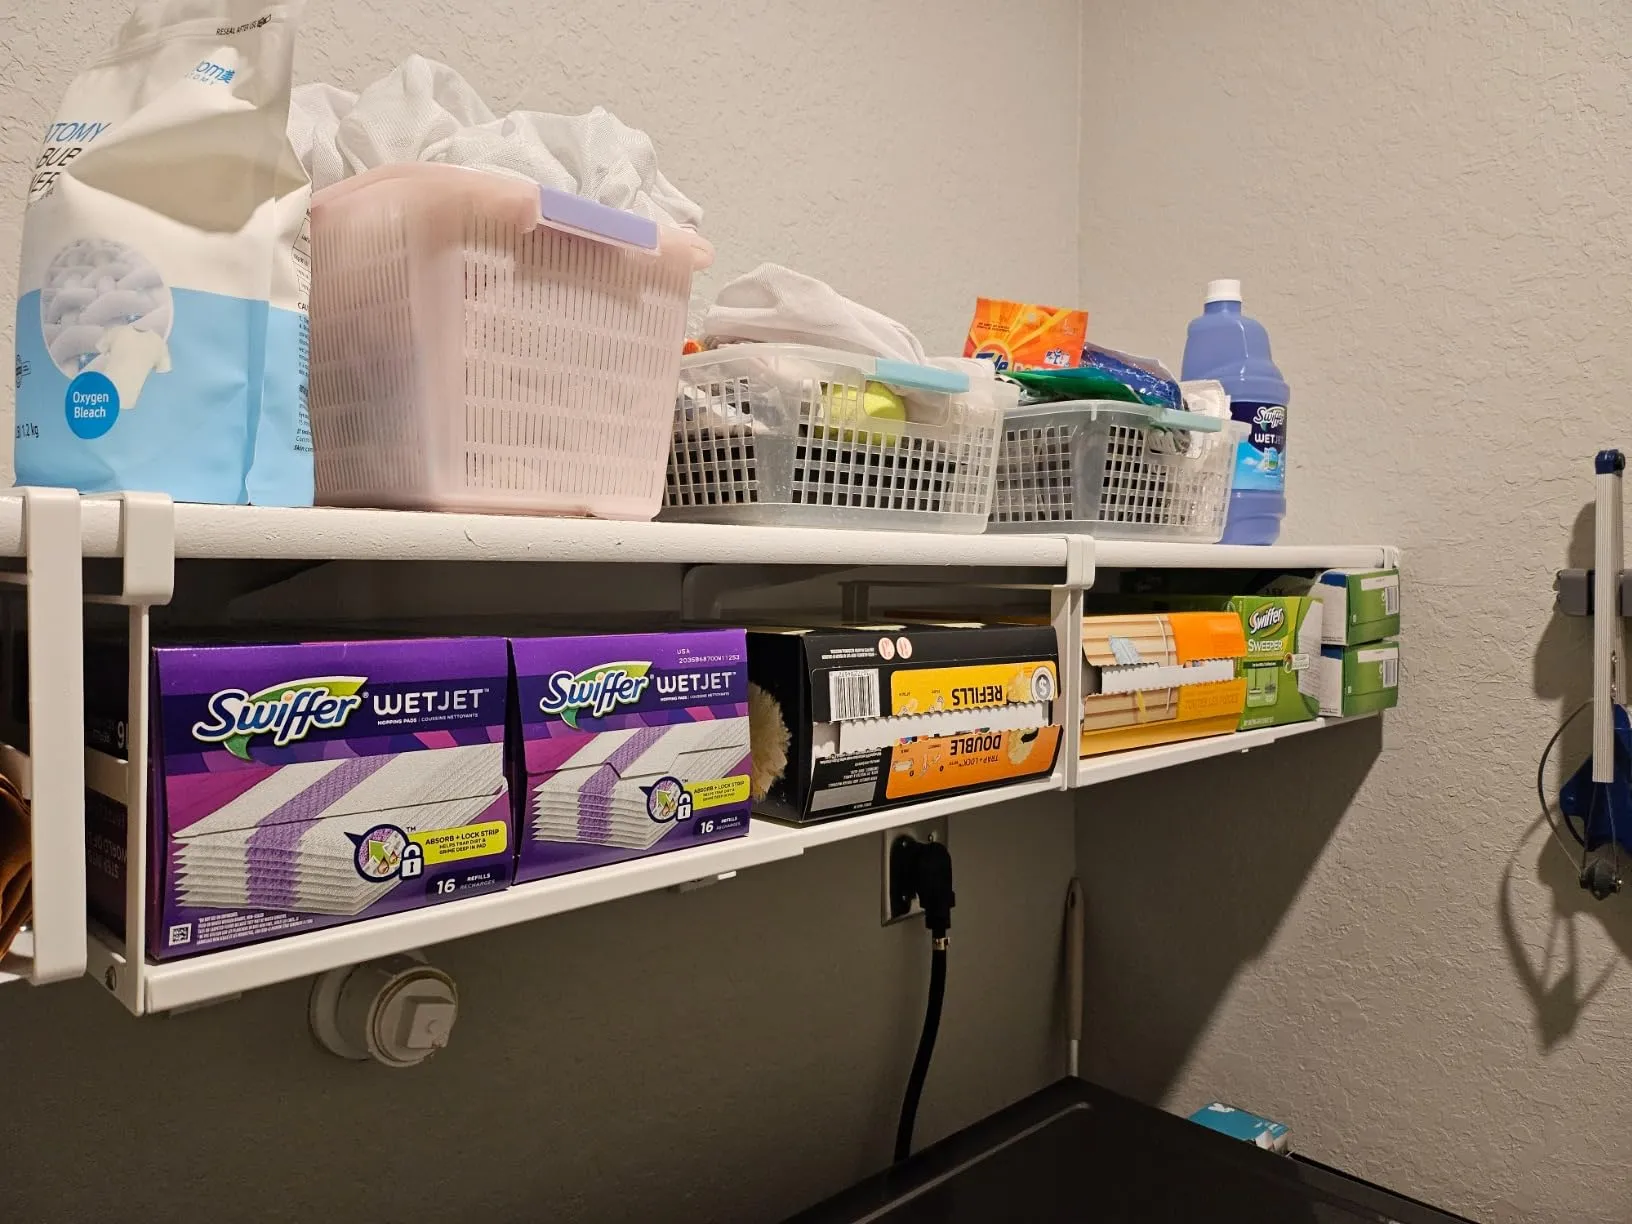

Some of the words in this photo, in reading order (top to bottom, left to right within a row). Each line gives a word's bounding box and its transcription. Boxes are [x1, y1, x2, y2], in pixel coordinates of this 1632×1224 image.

[216, 27, 235, 35] RESEAL
[72, 391, 109, 405] Oxygen
[74, 406, 106, 418] Bleach
[1250, 607, 1283, 634] Swiffer
[1247, 639, 1283, 652] SWEEPER
[540, 668, 650, 718] Swiffer
[656, 671, 733, 694] WETJET
[951, 684, 1003, 706] REFILLS
[191, 685, 362, 747] Swiffer
[373, 688, 484, 716] WETJET
[950, 734, 1002, 756] DOUBLE
[700, 820, 714, 834] 16
[425, 835, 455, 846] ABSORB
[461, 832, 480, 840] LOCK
[480, 828, 500, 838] STRIP
[459, 878, 496, 890] RECHARGES
[467, 872, 491, 882] REFILLS
[436, 878, 456, 895] 16
